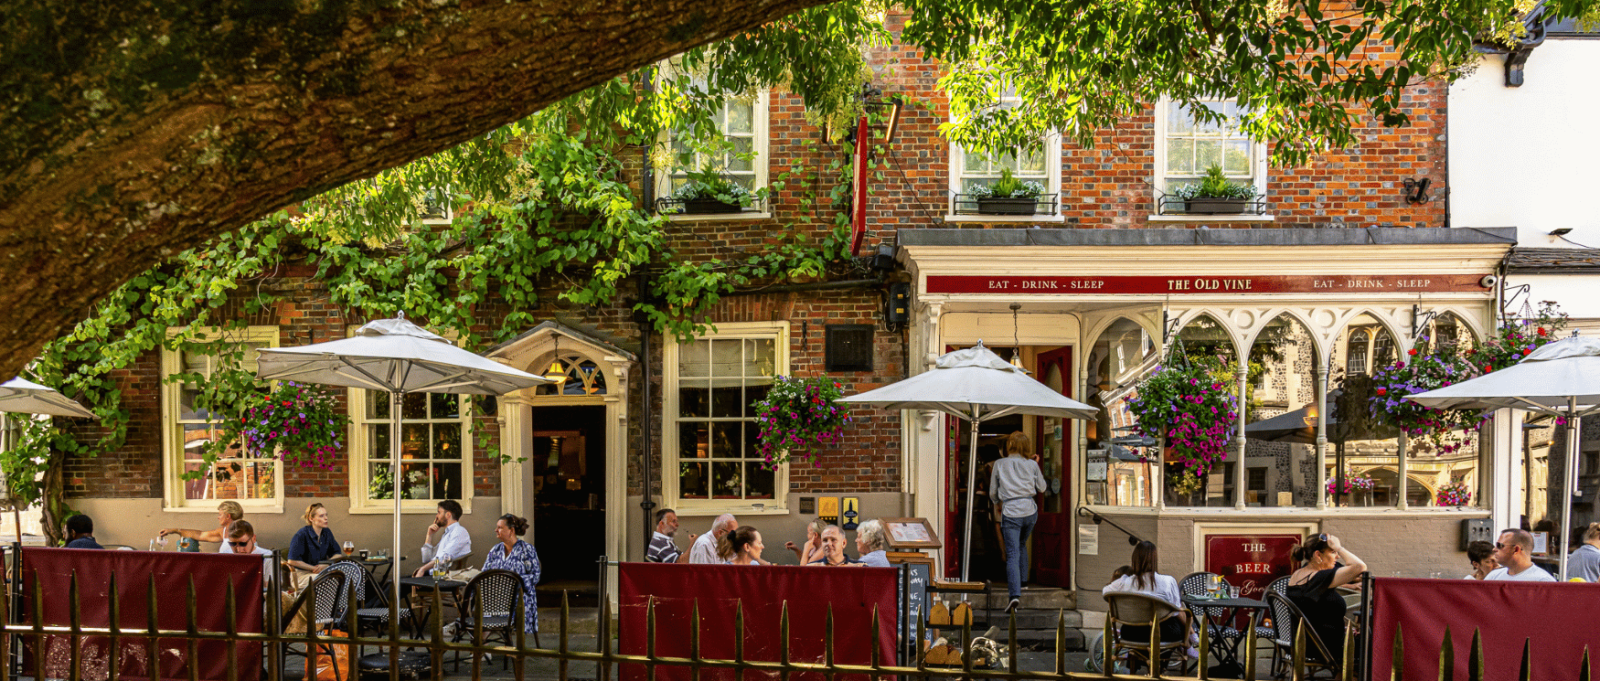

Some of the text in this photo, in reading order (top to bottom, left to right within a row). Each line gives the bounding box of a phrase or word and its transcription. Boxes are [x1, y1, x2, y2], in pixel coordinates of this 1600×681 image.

[988, 280, 1010, 289] EAT
[1022, 280, 1058, 289] DRINK
[1070, 280, 1104, 289] SLEEP
[1167, 278, 1252, 291] THE OLD VINE
[1313, 279, 1335, 288] EAT
[1347, 279, 1384, 288] DRINK
[1396, 279, 1431, 288] SLEEP
[1241, 543, 1267, 552] THE
[1236, 563, 1271, 574] BEER
